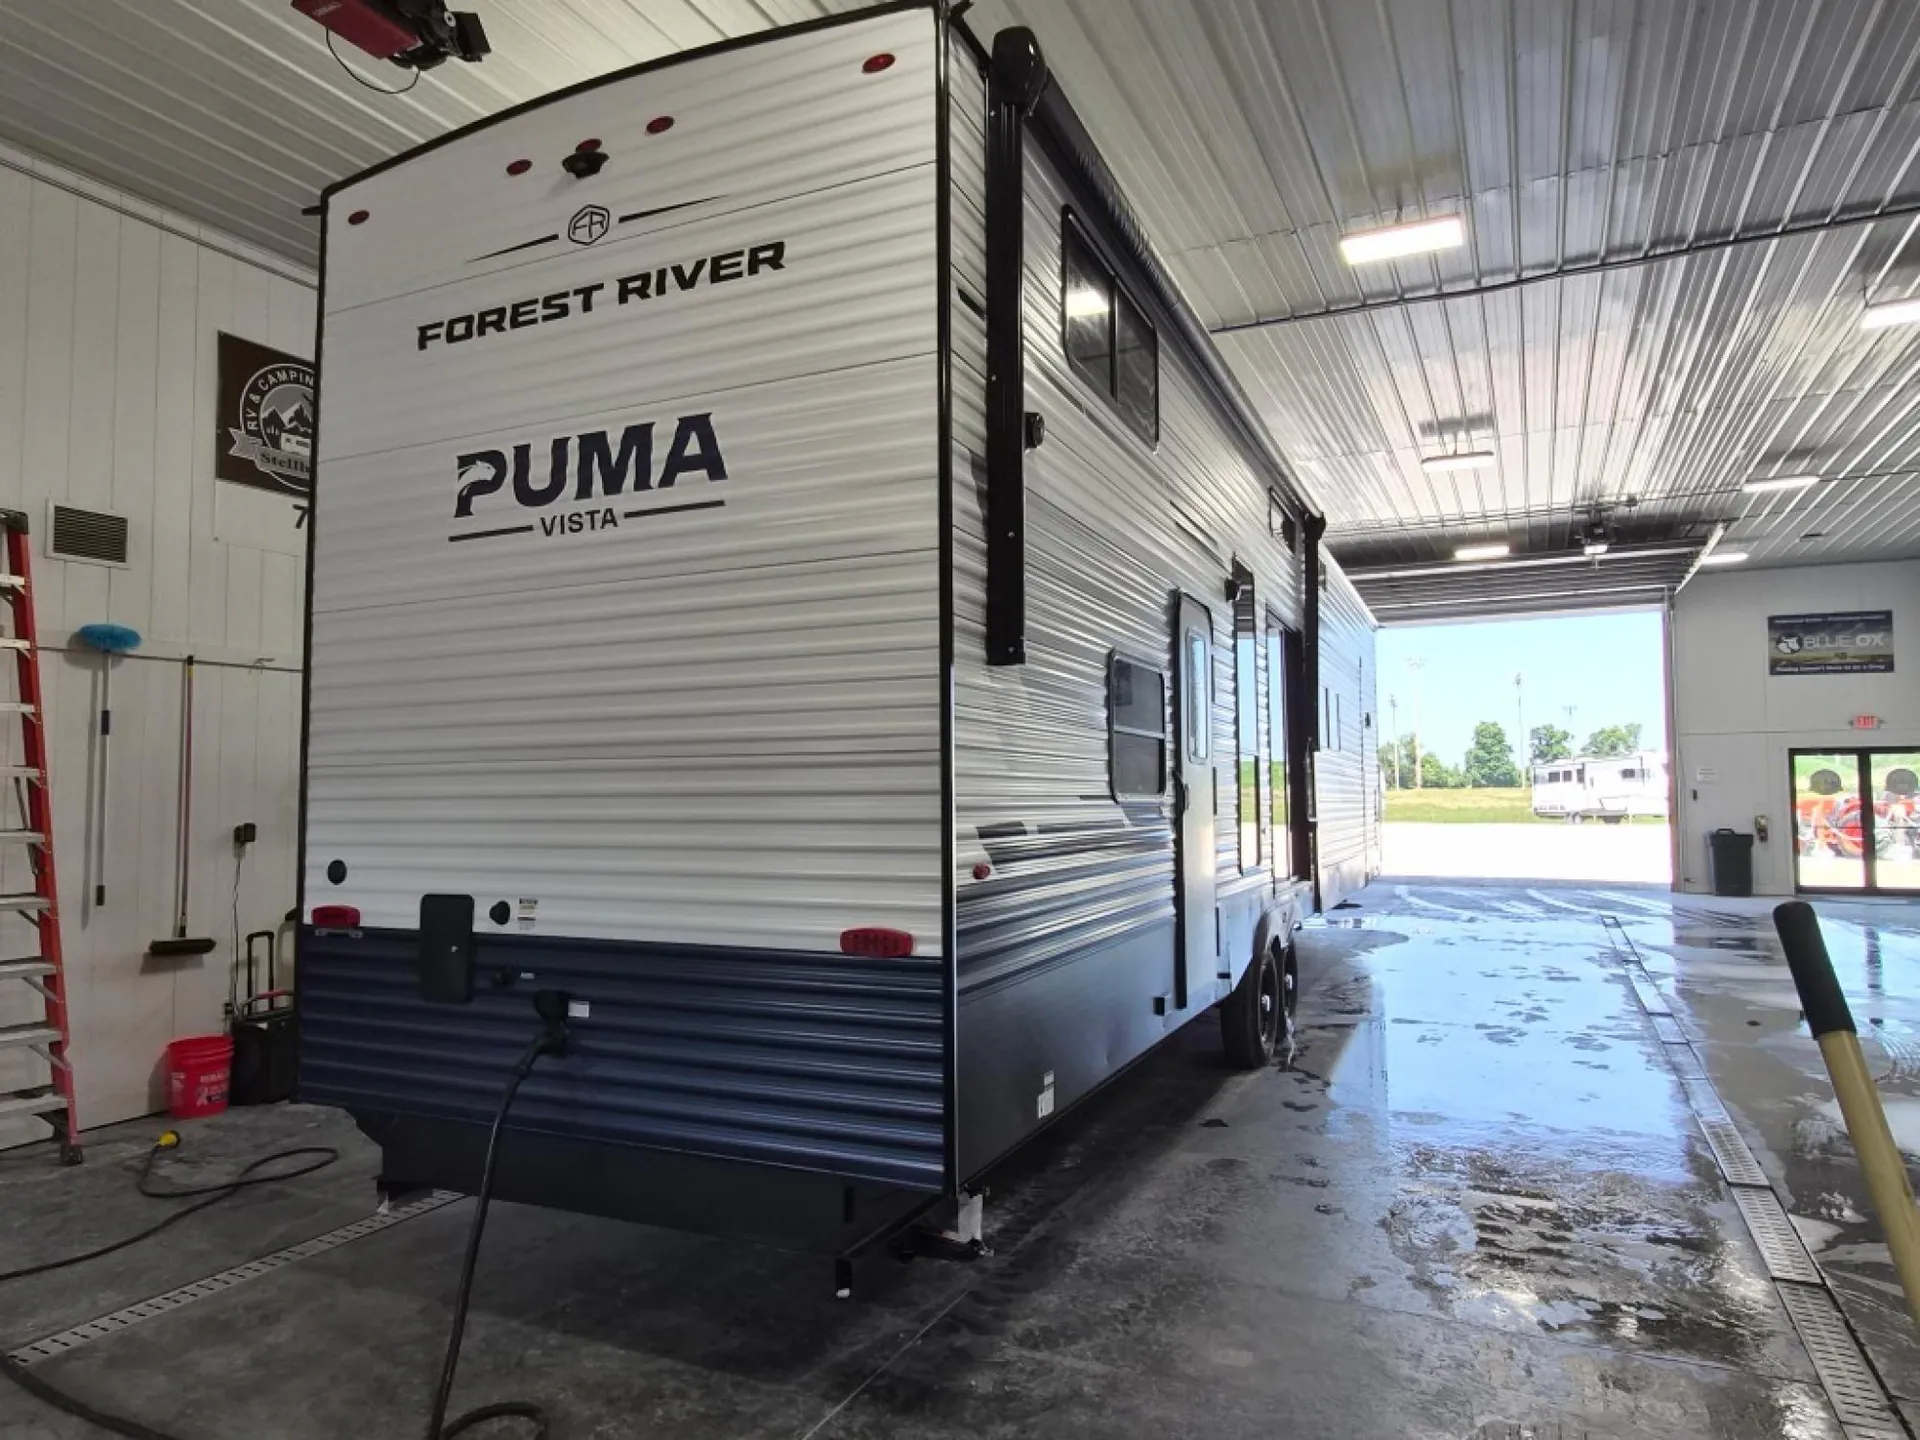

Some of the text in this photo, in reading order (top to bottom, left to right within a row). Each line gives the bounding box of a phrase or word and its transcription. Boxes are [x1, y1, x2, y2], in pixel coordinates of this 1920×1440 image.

[417, 241, 786, 351] FOREST RIVER
[244, 408, 259, 430] RV
[453, 412, 728, 518] PUMA
[540, 507, 618, 537] VISTA
[1803, 632, 1884, 650] BLUE OX
